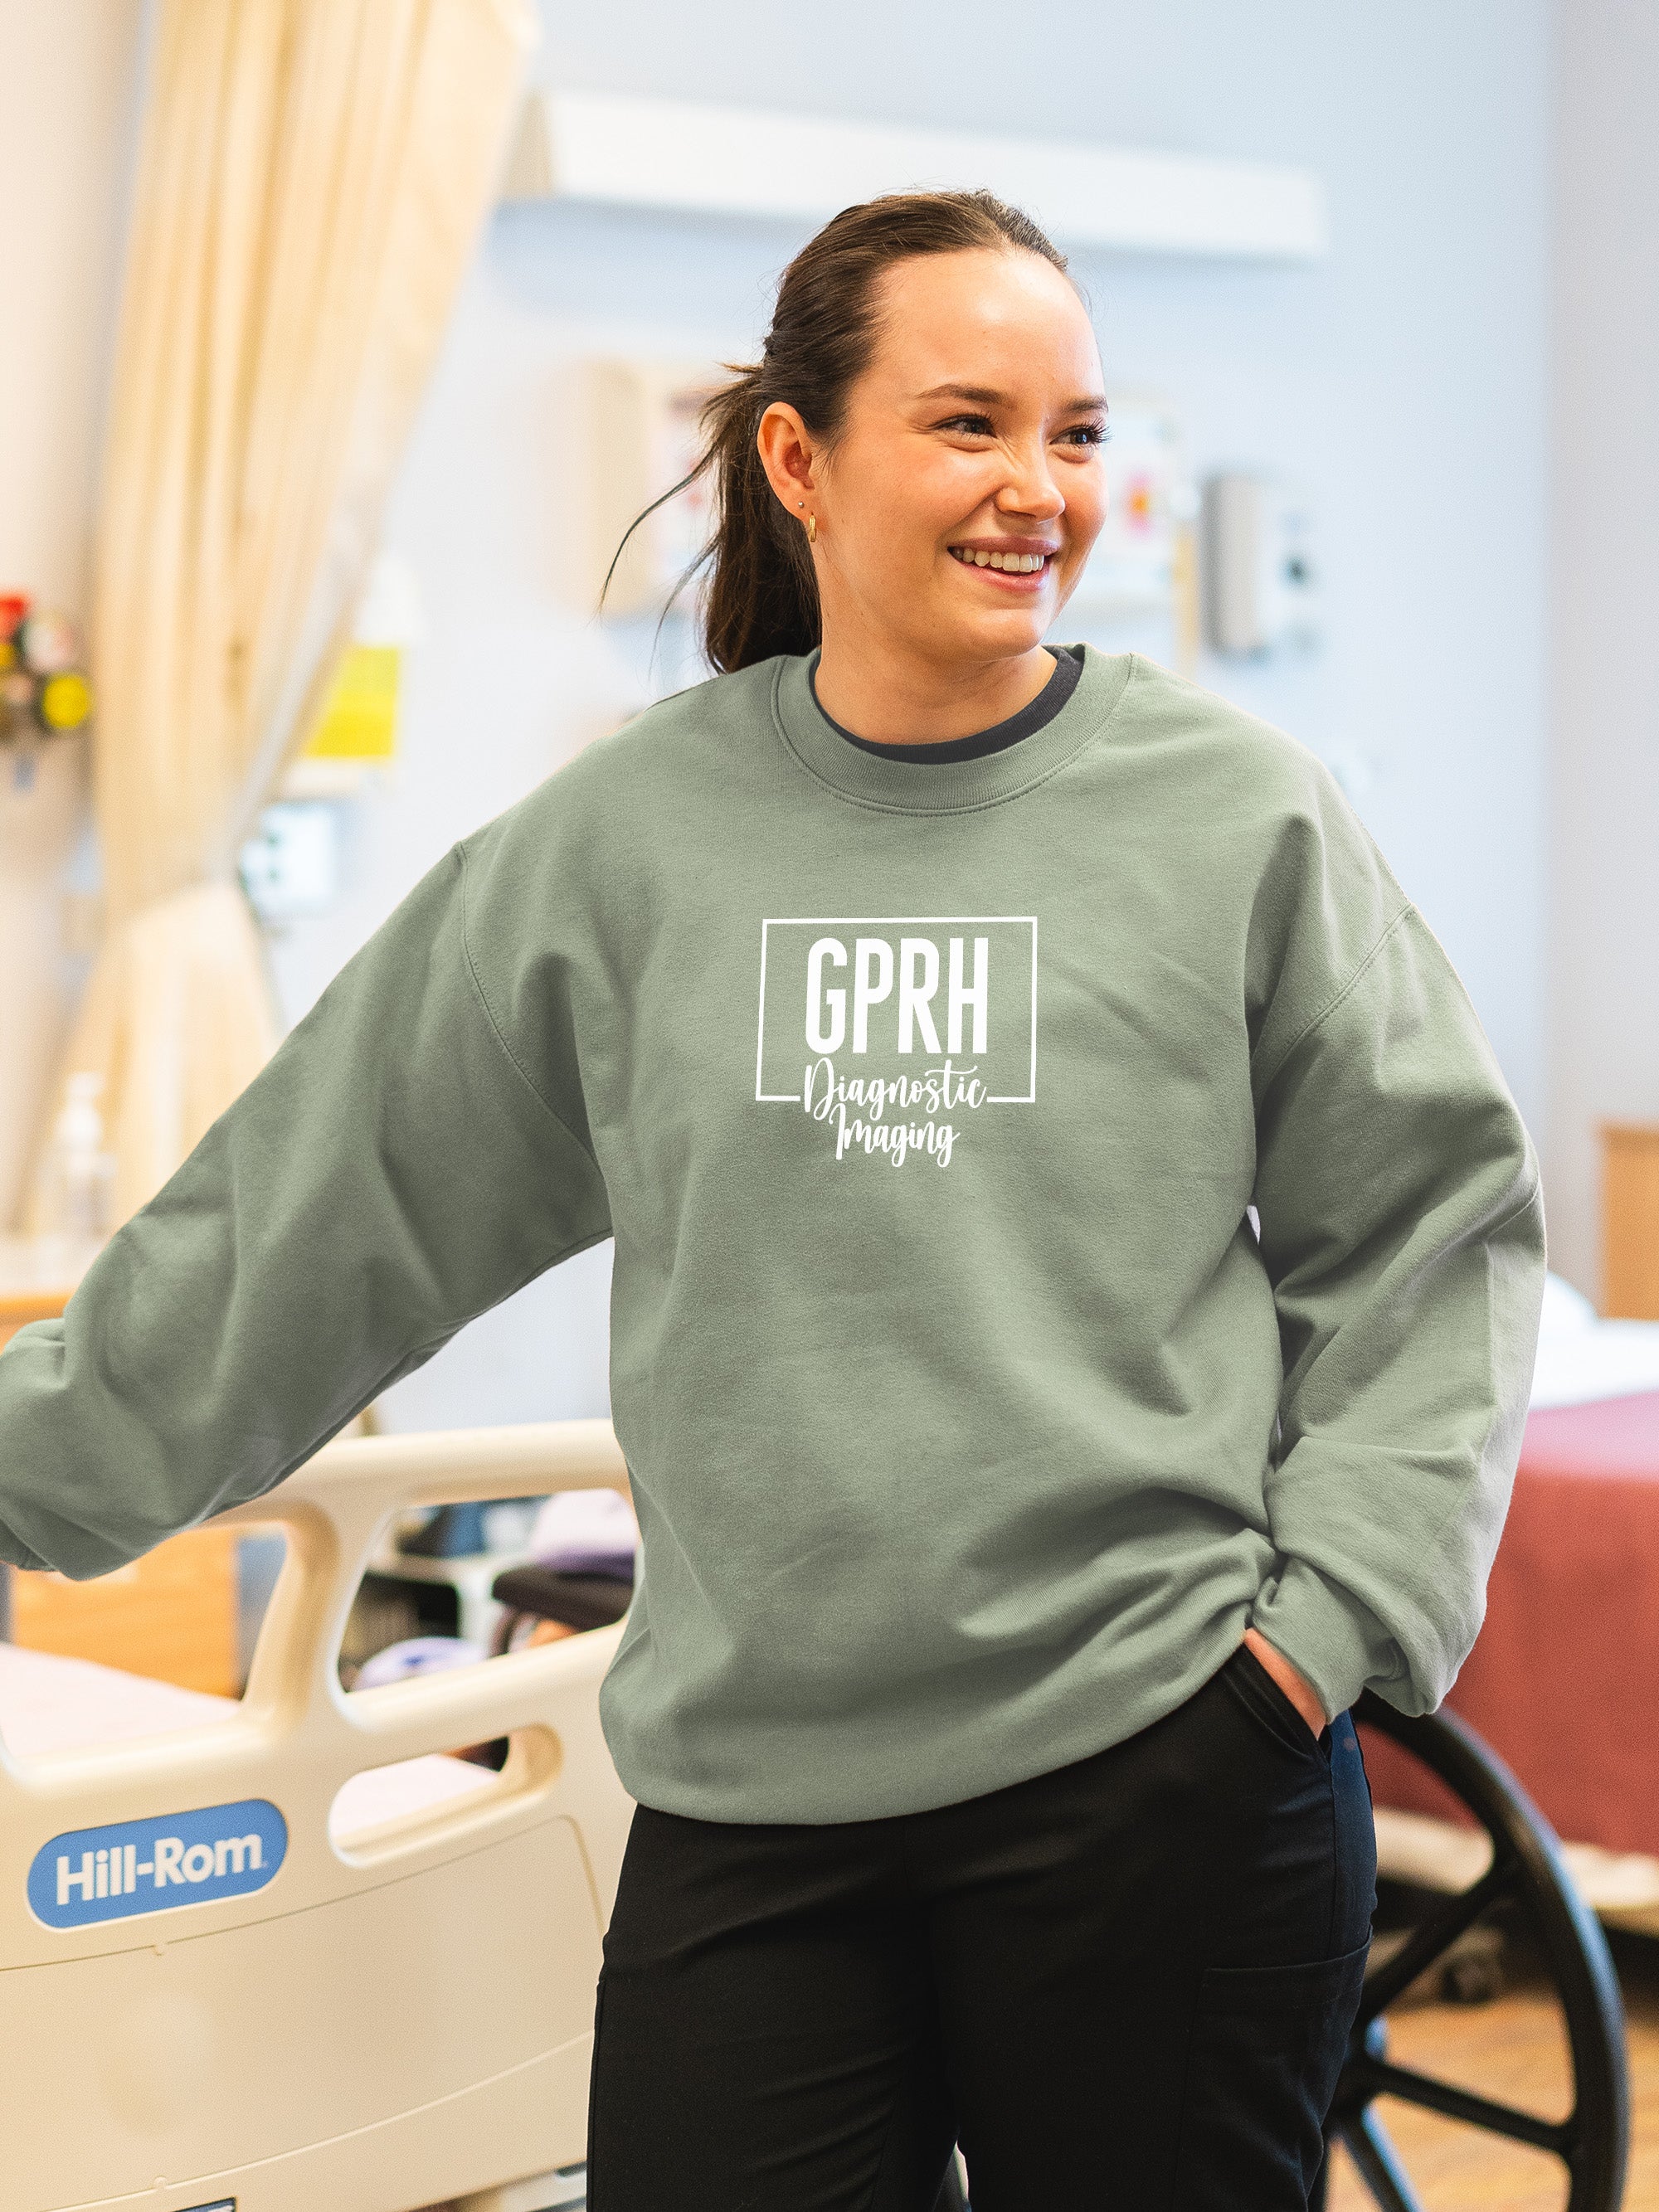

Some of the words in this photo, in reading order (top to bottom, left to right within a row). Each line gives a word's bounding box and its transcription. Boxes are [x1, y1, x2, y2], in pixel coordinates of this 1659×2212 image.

[805, 937, 989, 1053] GPRH
[804, 1057, 987, 1121] Diagnostic
[829, 1103, 961, 1167] Imaging
[56, 1834, 263, 1906] Hill-Rom
